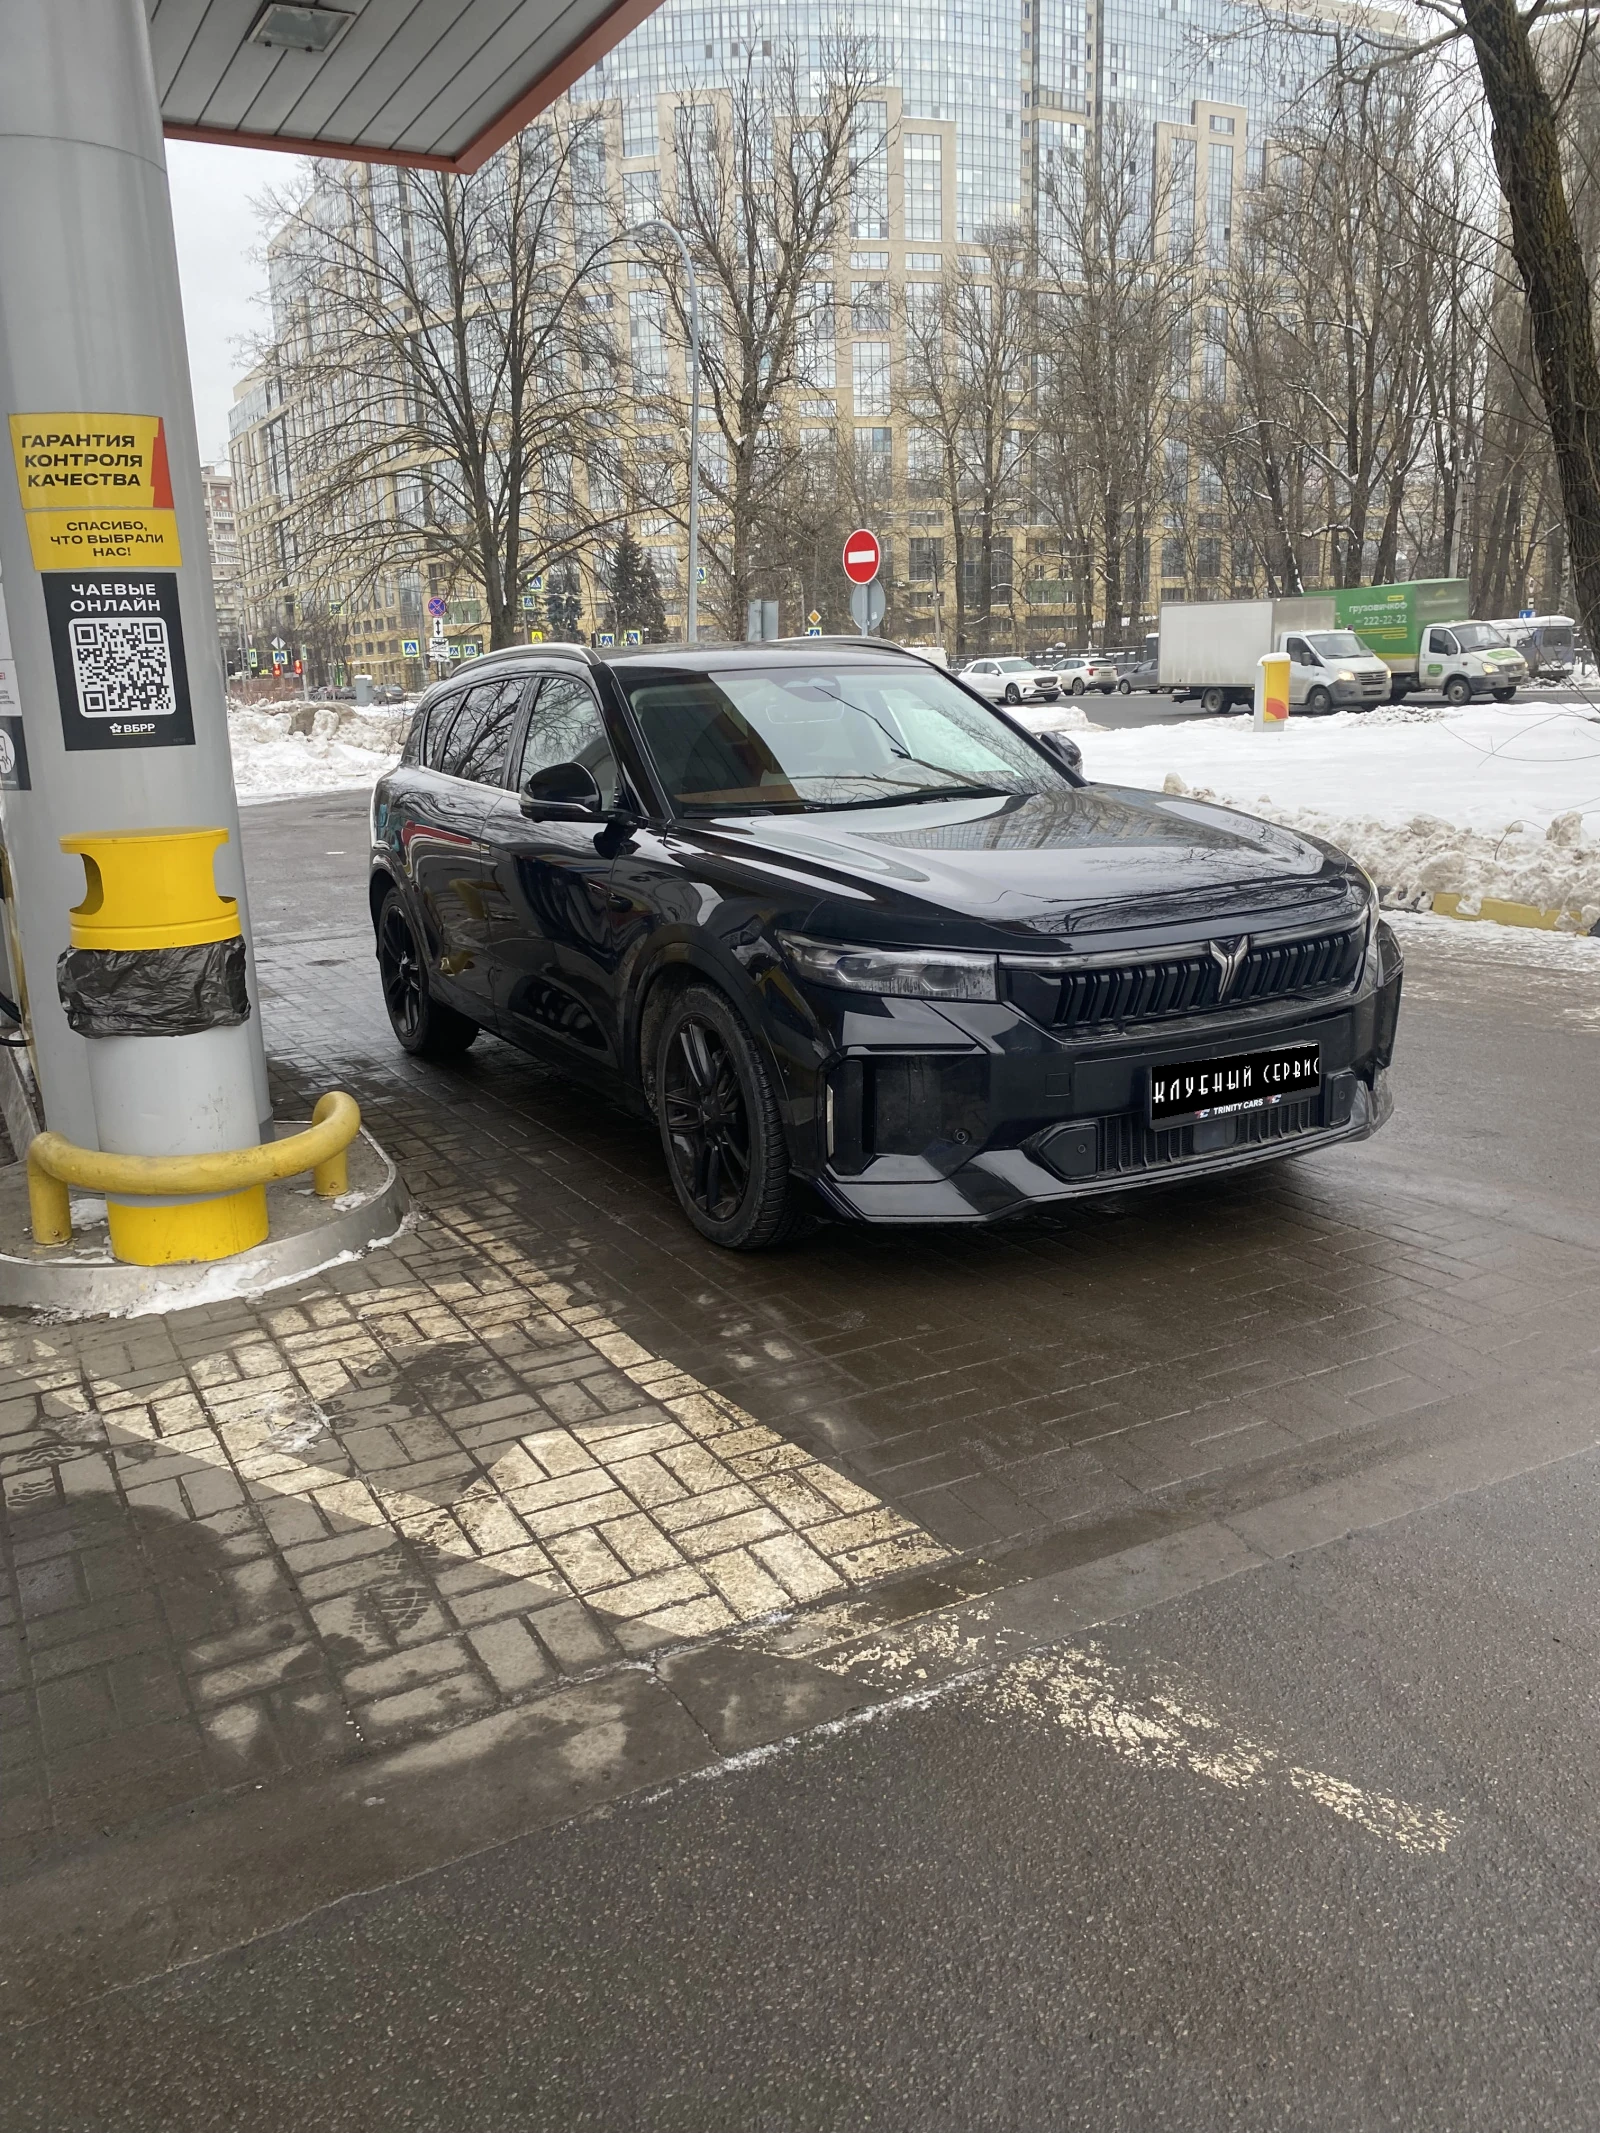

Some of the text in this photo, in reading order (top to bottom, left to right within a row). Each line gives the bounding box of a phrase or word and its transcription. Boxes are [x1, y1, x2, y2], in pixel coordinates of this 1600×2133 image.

[21, 433, 135, 448] ГАРАНТИЯ
[25, 453, 143, 467] КОНТРОЛЯ
[28, 473, 141, 487] КАЧЕСТВА
[66, 521, 148, 532] СПАСИБО,
[50, 533, 164, 545] ЧТО ВЫБРАЛИ
[93, 547, 131, 557] НАС!
[71, 583, 156, 596] ЧАЕВЫЕ
[70, 597, 161, 612] ОНЛАЙН
[123, 723, 156, 733] ВБРР
[1213, 1102, 1243, 1115] TRINITY
[1243, 1098, 1264, 1109] CARS
